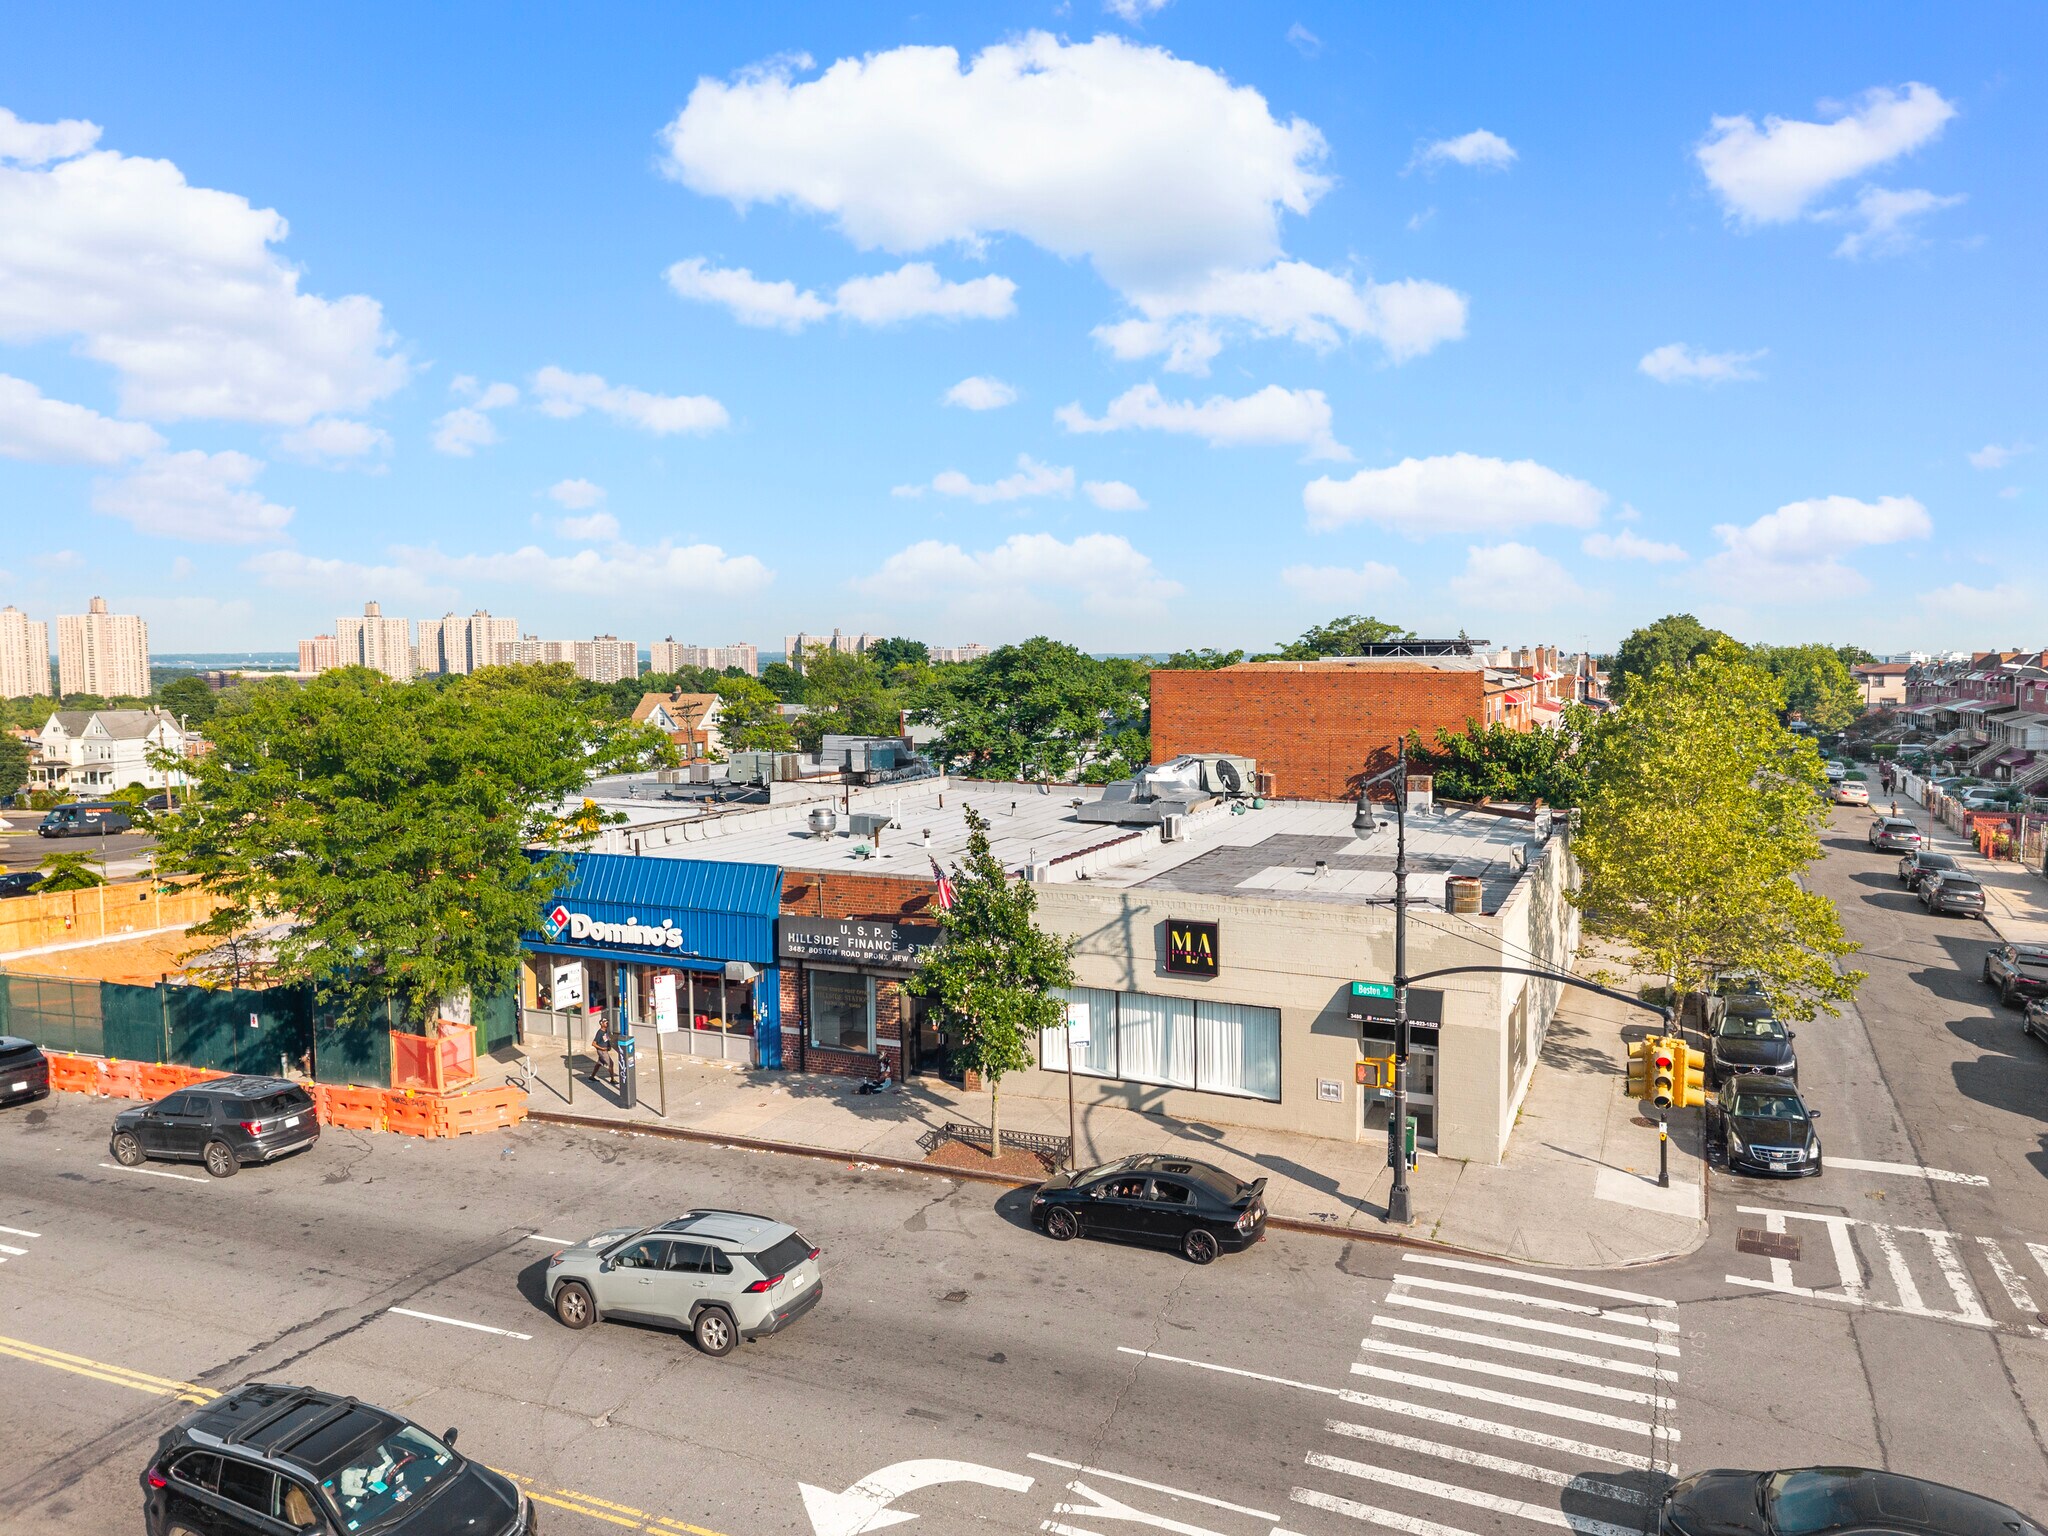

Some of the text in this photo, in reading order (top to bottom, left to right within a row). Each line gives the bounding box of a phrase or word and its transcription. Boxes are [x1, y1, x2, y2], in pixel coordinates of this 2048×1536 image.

[570, 913, 684, 948] Domino's
[787, 932, 840, 947] HILLSIDE
[847, 937, 899, 952] FINANCE
[808, 947, 838, 956] BOSTON
[841, 950, 861, 958] ROAD
[864, 952, 889, 961] BRONX
[892, 954, 909, 963] NEW
[1358, 984, 1380, 996] Boston
